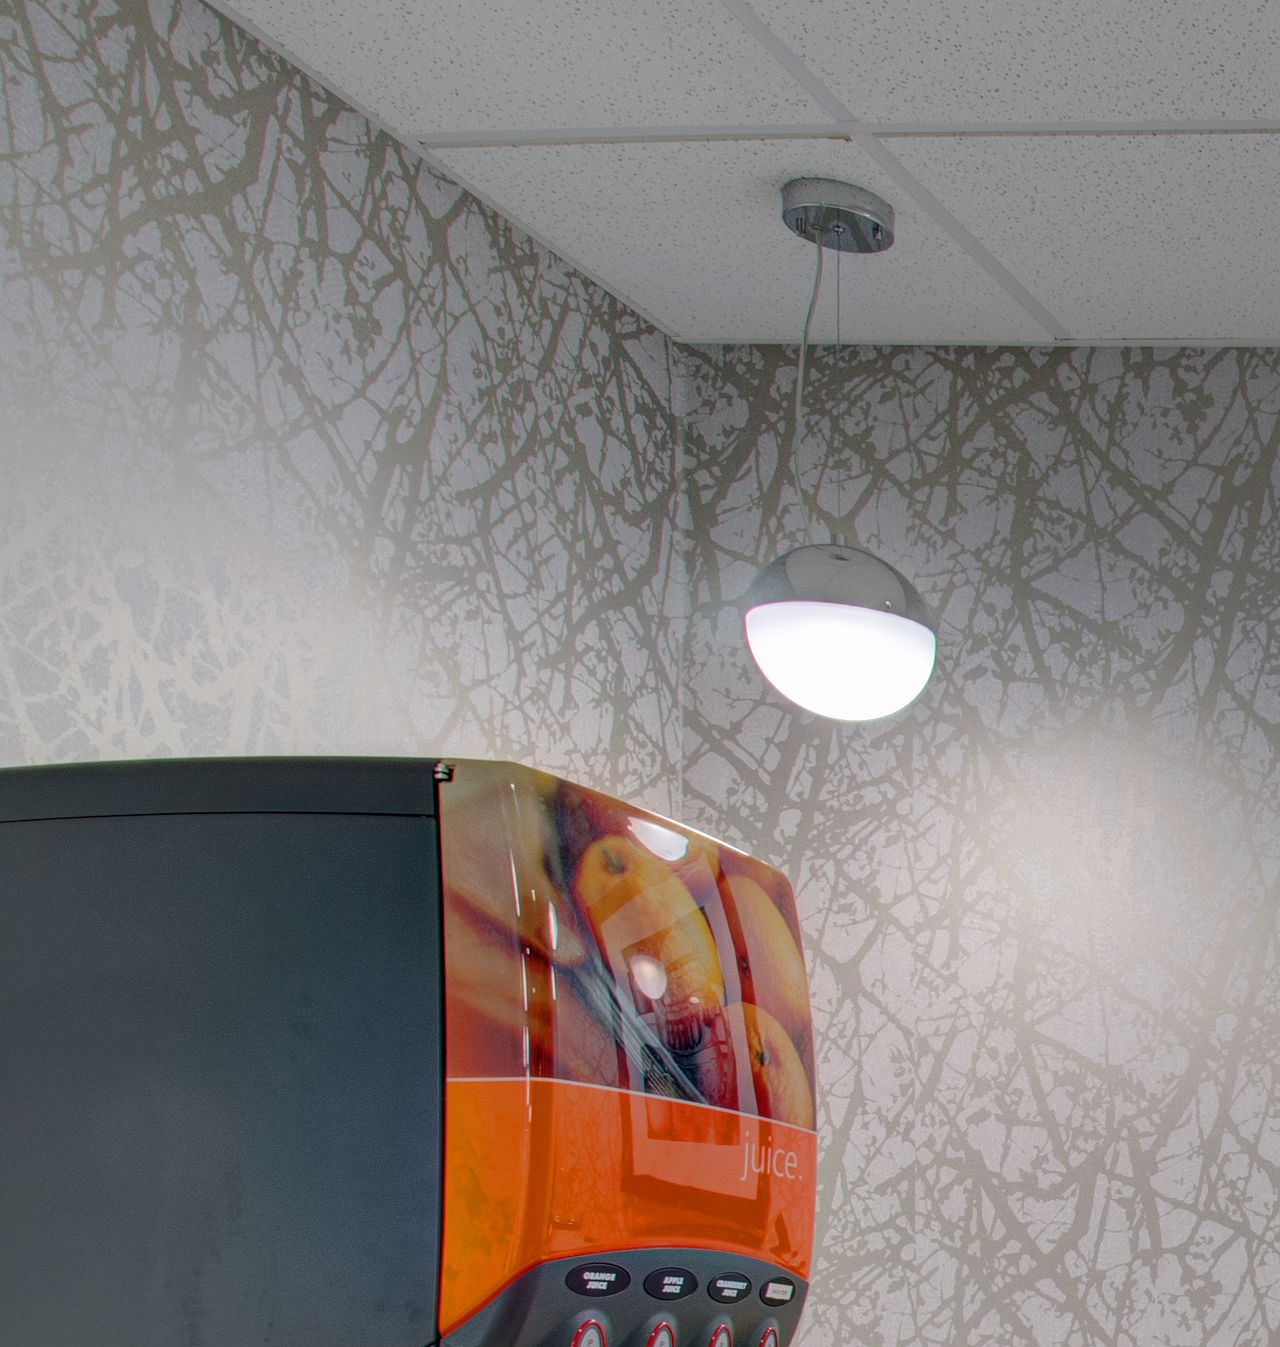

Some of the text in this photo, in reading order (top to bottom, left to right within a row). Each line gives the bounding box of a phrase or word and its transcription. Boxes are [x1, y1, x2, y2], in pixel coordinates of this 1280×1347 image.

[740, 1130, 802, 1181] juice.
[583, 1271, 616, 1282] ORANGE
[663, 1276, 684, 1285] APPLE
[586, 1281, 608, 1290] JUICE
[662, 1285, 681, 1293] JUICE
